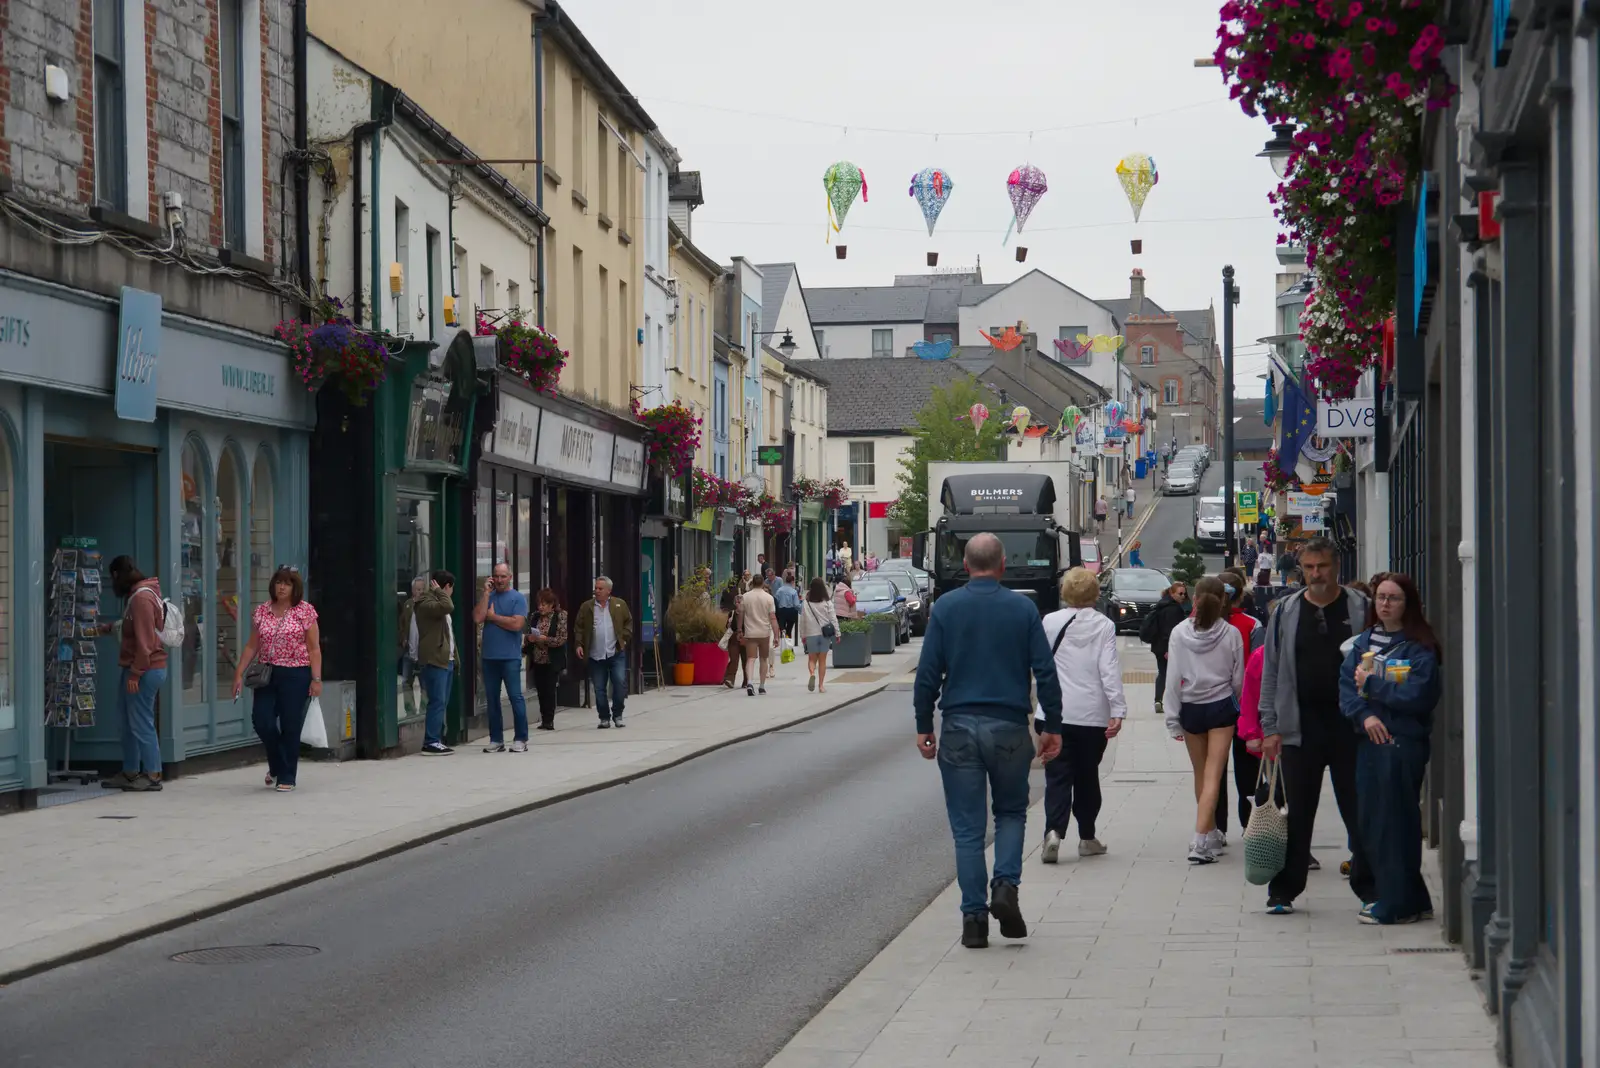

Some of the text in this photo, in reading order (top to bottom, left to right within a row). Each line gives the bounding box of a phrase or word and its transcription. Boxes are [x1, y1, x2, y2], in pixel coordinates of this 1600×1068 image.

[1328, 408, 1374, 428] DV8
[560, 424, 594, 464] MOFFITTS
[970, 488, 1024, 496] BULMERS
